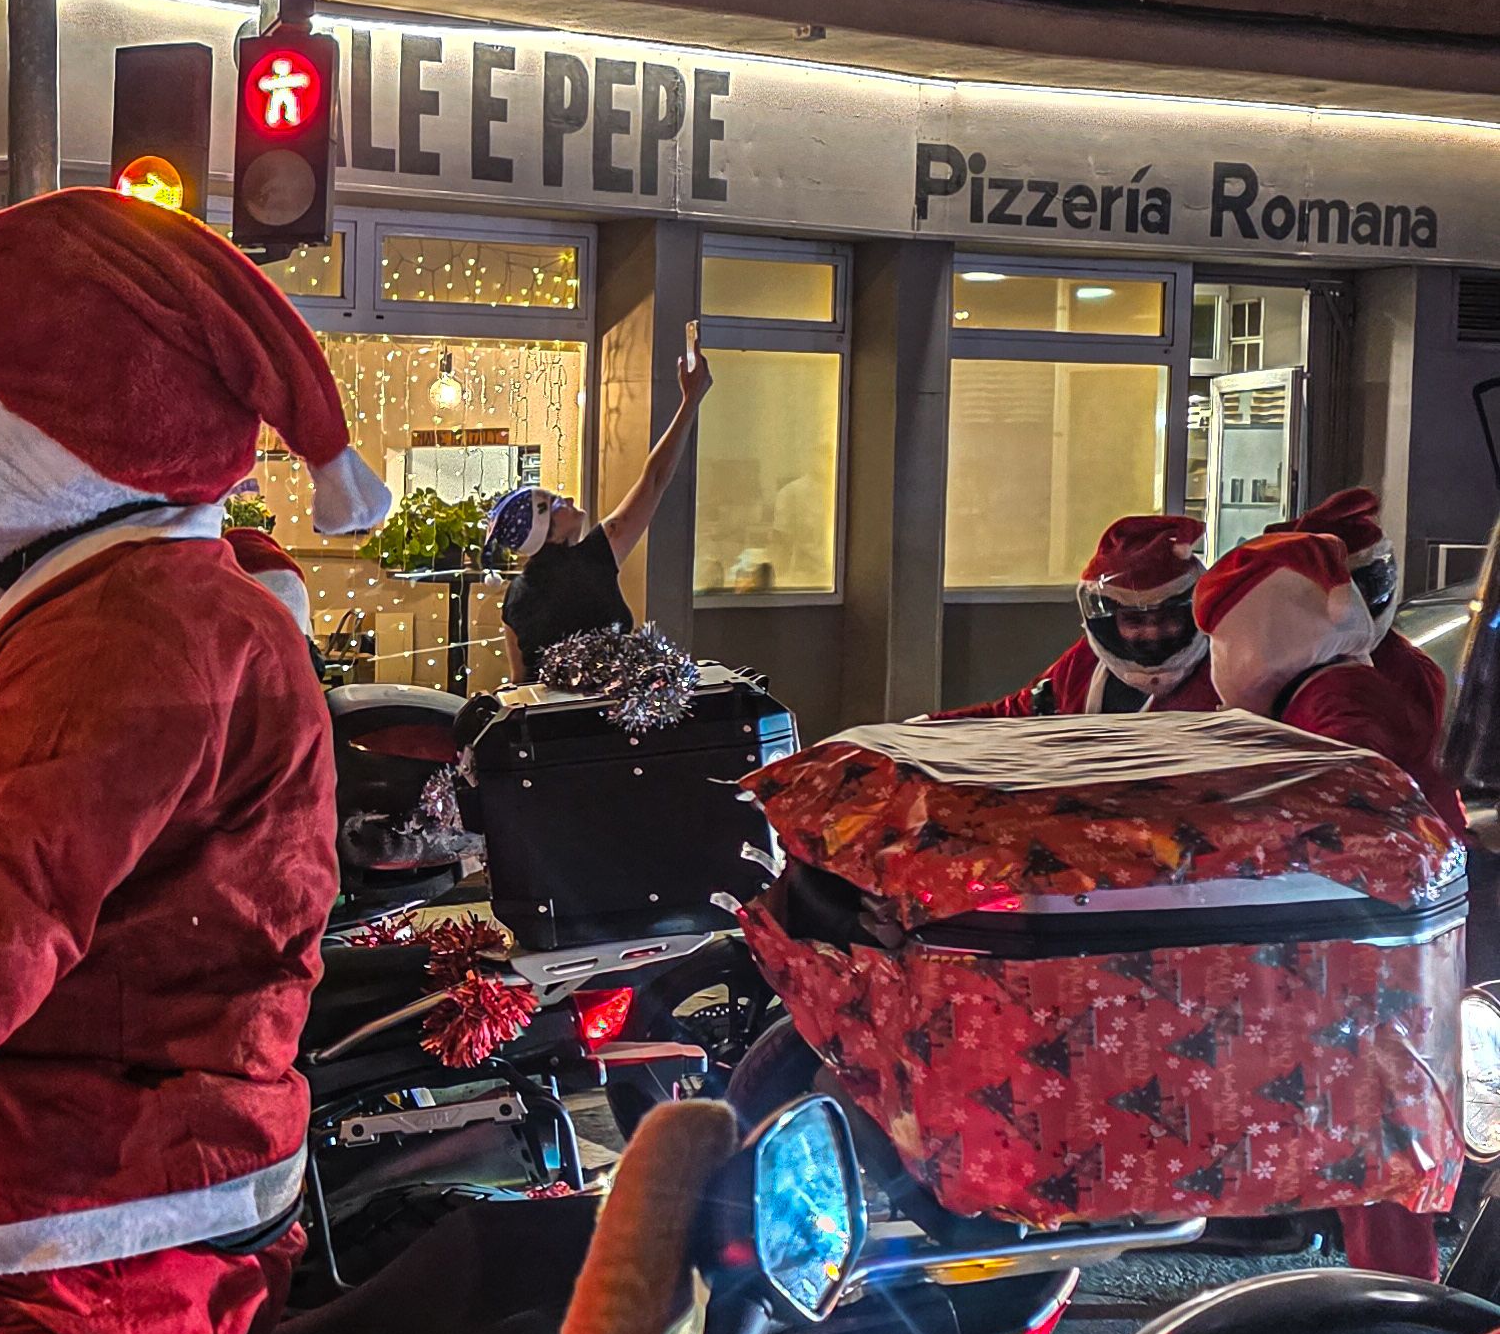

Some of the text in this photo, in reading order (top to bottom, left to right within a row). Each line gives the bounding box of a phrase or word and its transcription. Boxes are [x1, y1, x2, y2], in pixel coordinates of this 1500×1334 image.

[470, 42, 516, 184] E
[542, 51, 731, 202] PEPE
[915, 142, 1438, 249] Pizzería Romana
